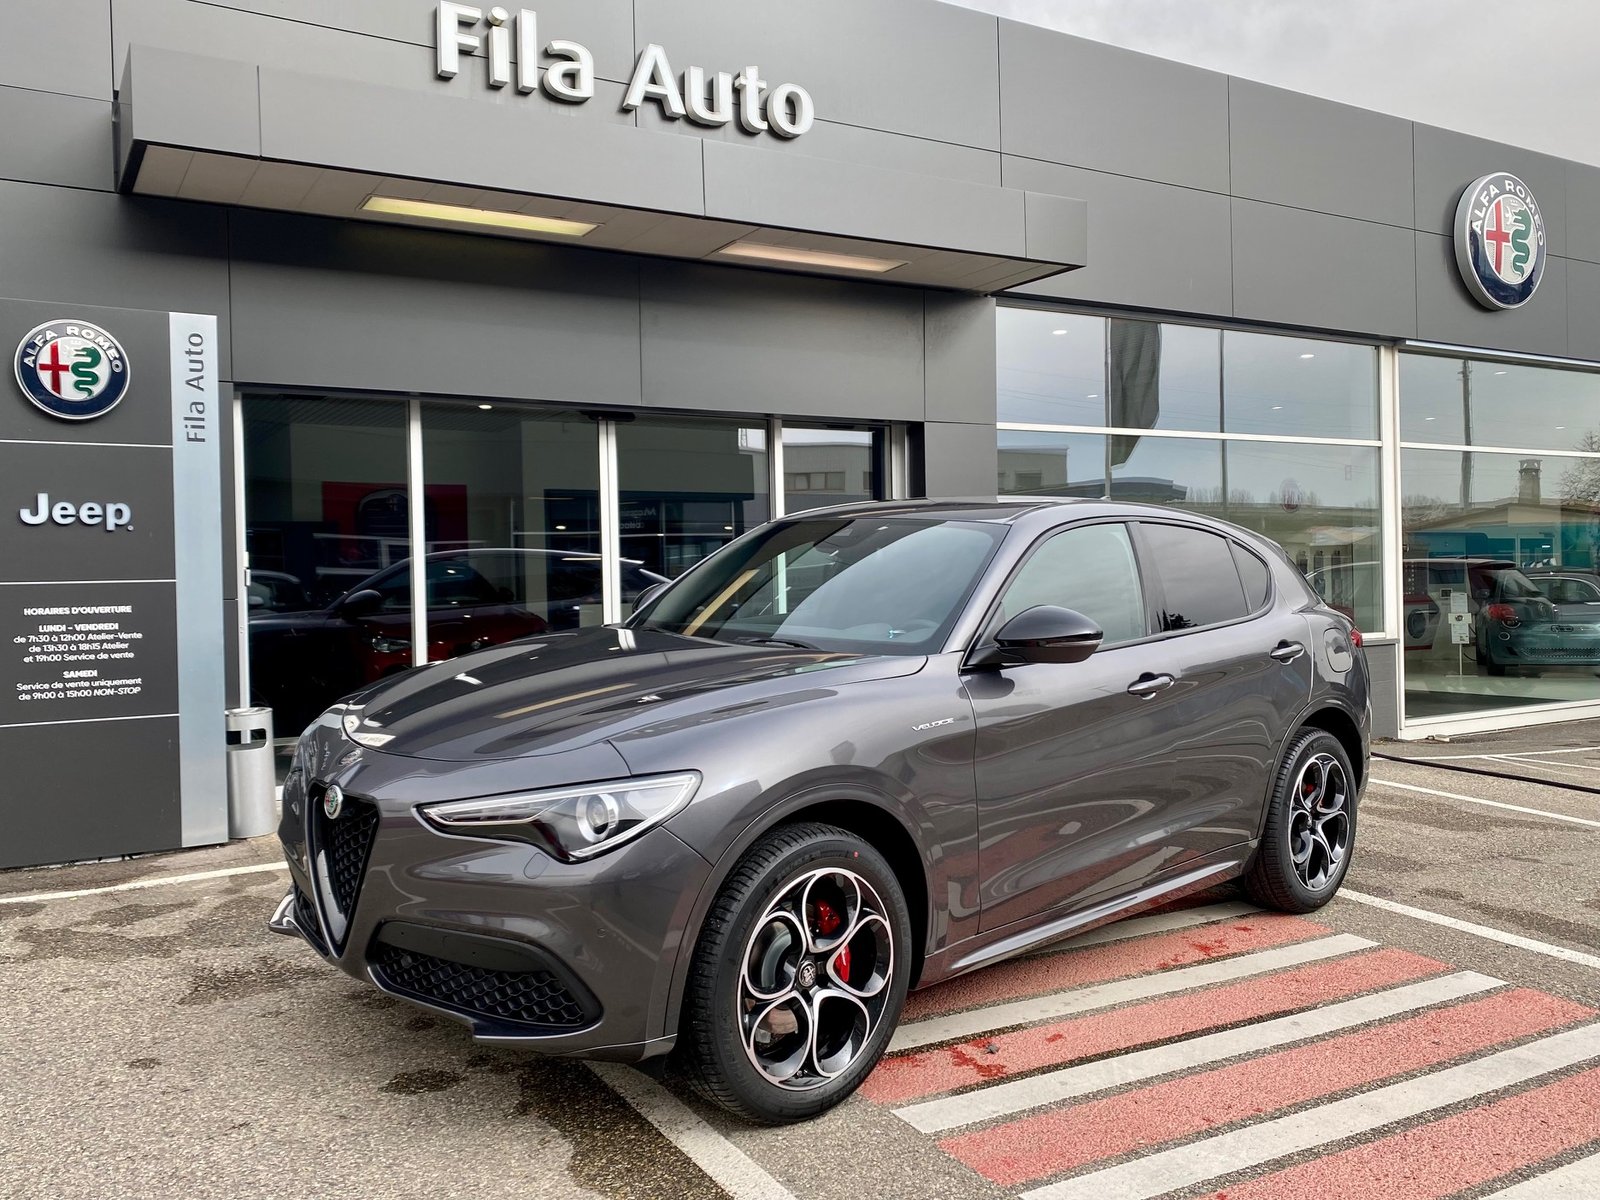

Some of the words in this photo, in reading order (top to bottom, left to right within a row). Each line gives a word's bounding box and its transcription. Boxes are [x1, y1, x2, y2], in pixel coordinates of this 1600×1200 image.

[436, 0, 595, 101] Fila
[622, 43, 815, 138] Auto
[1471, 184, 1500, 235] ALFA
[1504, 180, 1544, 246] ROMEO
[23, 329, 58, 368] ALFA
[66, 325, 122, 373] ROMEO
[185, 333, 205, 392] Auto
[183, 401, 206, 443] Fila
[19, 492, 133, 531] Jeep
[23, 607, 70, 616] HORAIRES
[71, 605, 132, 615] D'OUVERTURE
[39, 624, 66, 632] LUNDI
[74, 622, 119, 631] VENDREDI
[27, 634, 49, 643] 7h30
[51, 634, 58, 642] à
[60, 633, 86, 641] 12h00
[87, 632, 143, 641] Atelier-Vente
[28, 645, 41, 653] de
[42, 644, 68, 652] 13h30
[78, 643, 100, 651] 18h15
[102, 641, 129, 650] Atelier
[23, 655, 33, 663] et
[35, 654, 61, 662] 19h00
[63, 653, 95, 661] Service
[110, 651, 135, 659] vente
[62, 669, 98, 678] SAMEDI
[16, 682, 49, 691] Service
[51, 681, 63, 689] de
[65, 680, 90, 688] vente
[91, 678, 142, 688] uniquement
[18, 693, 31, 701] de
[32, 691, 55, 700] 9h00
[66, 689, 92, 698] 15h00
[93, 686, 141, 696] NON-STOP
